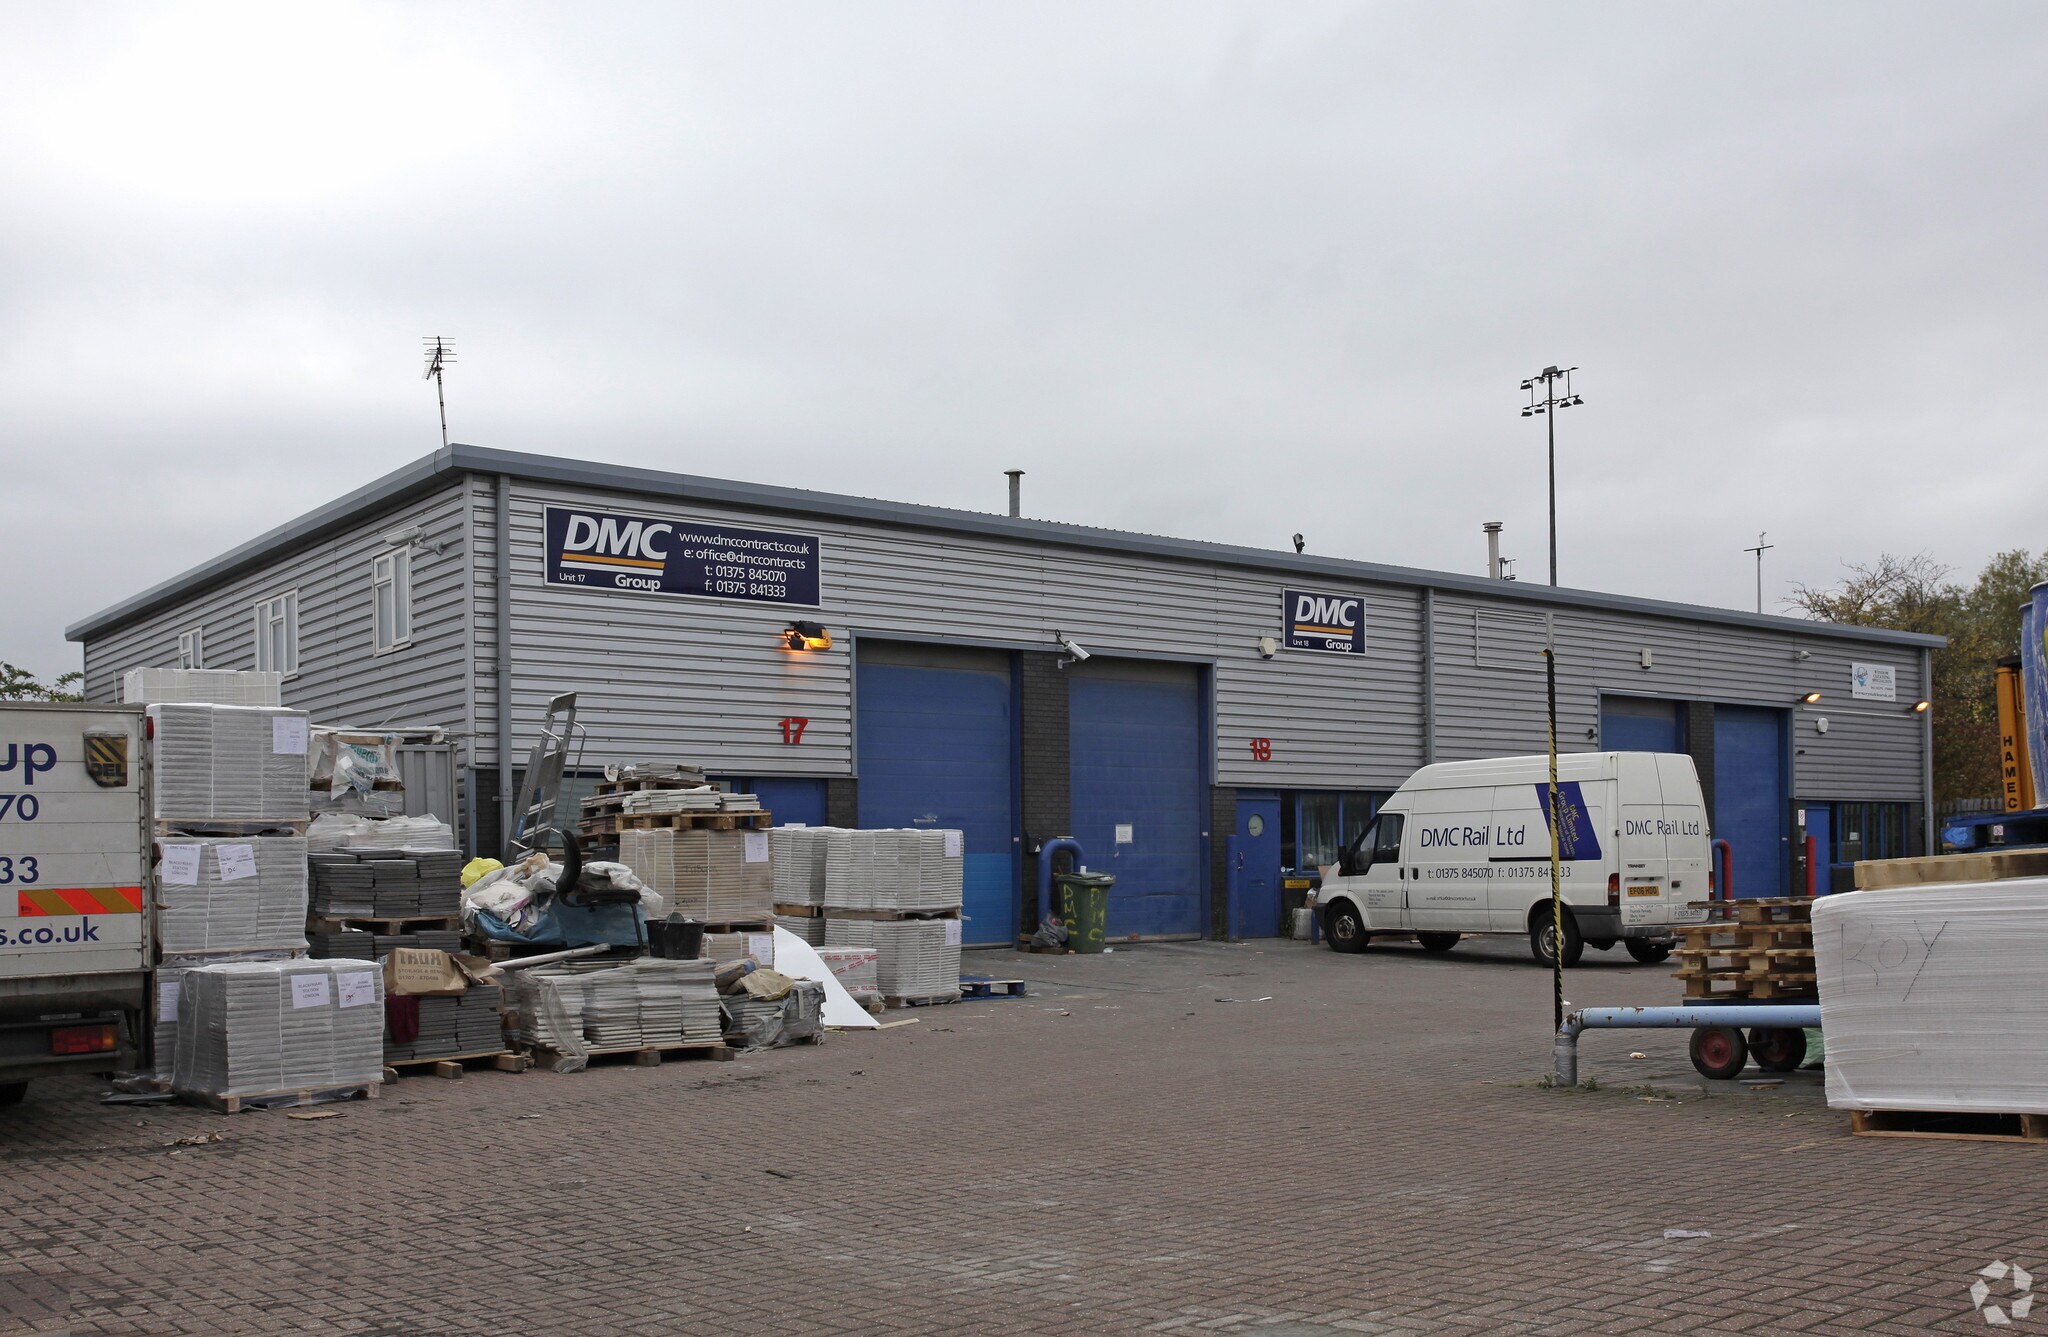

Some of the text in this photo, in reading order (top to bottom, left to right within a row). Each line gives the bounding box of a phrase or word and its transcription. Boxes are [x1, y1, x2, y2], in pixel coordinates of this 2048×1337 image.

[563, 514, 672, 560] DMC
[679, 532, 810, 555] www.dmccontracts.co.uk
[684, 548, 806, 570] e: office@dmccontracts
[559, 572, 586, 583] Unit 17
[615, 573, 661, 592] Group
[704, 565, 787, 583] t: 01375 845070
[704, 580, 786, 598] f: 01375 841333
[1295, 595, 1358, 627] DMC
[1292, 639, 1303, 647] Unit
[1325, 638, 1352, 652] Group
[778, 716, 809, 745] 17
[1249, 737, 1273, 761] 18
[2002, 735, 2018, 809] HAMEC
[1558, 790, 1580, 842] Group Limited
[1569, 803, 1580, 821] DMC
[1421, 825, 1525, 847] DMC Rail Ltd
[1626, 820, 1700, 835] DMC Rail Ltd
[1427, 869, 1435, 879] t:
[1436, 868, 1459, 879] 01375
[1462, 868, 1494, 879] 845070
[1498, 867, 1505, 878] f:
[1508, 867, 1535, 878] 01375
